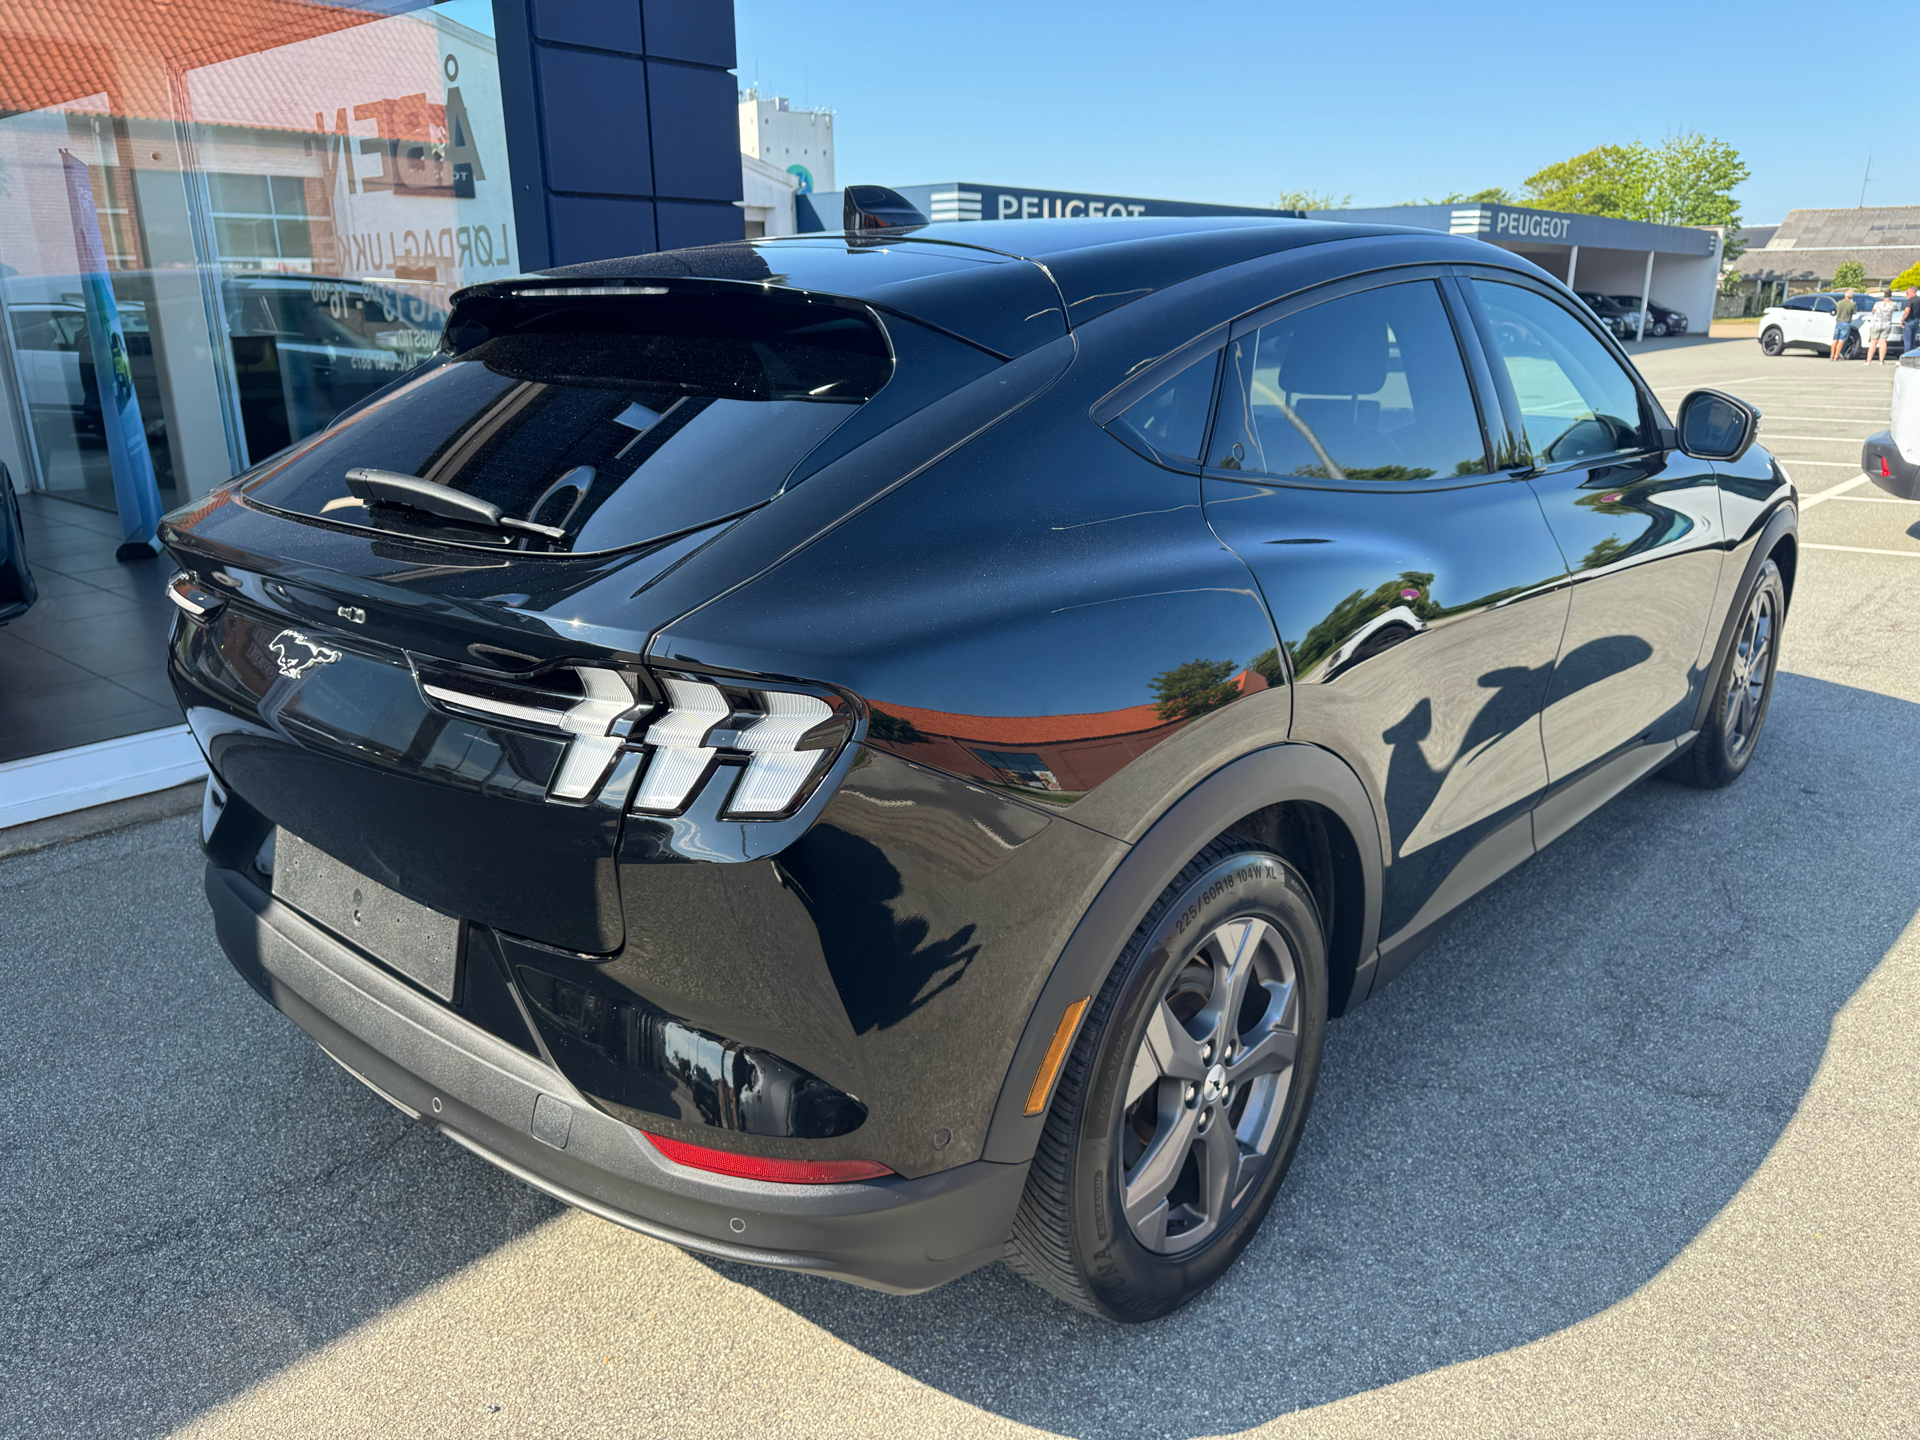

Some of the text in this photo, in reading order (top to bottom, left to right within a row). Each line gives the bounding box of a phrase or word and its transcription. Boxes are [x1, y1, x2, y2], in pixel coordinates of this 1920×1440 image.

[998, 194, 1145, 220] PEUGEOT
[1496, 211, 1571, 239] PEUGEOT
[1175, 865, 1277, 935] 225/60R18 104W XL
[1095, 1176, 1104, 1217] SEASON
